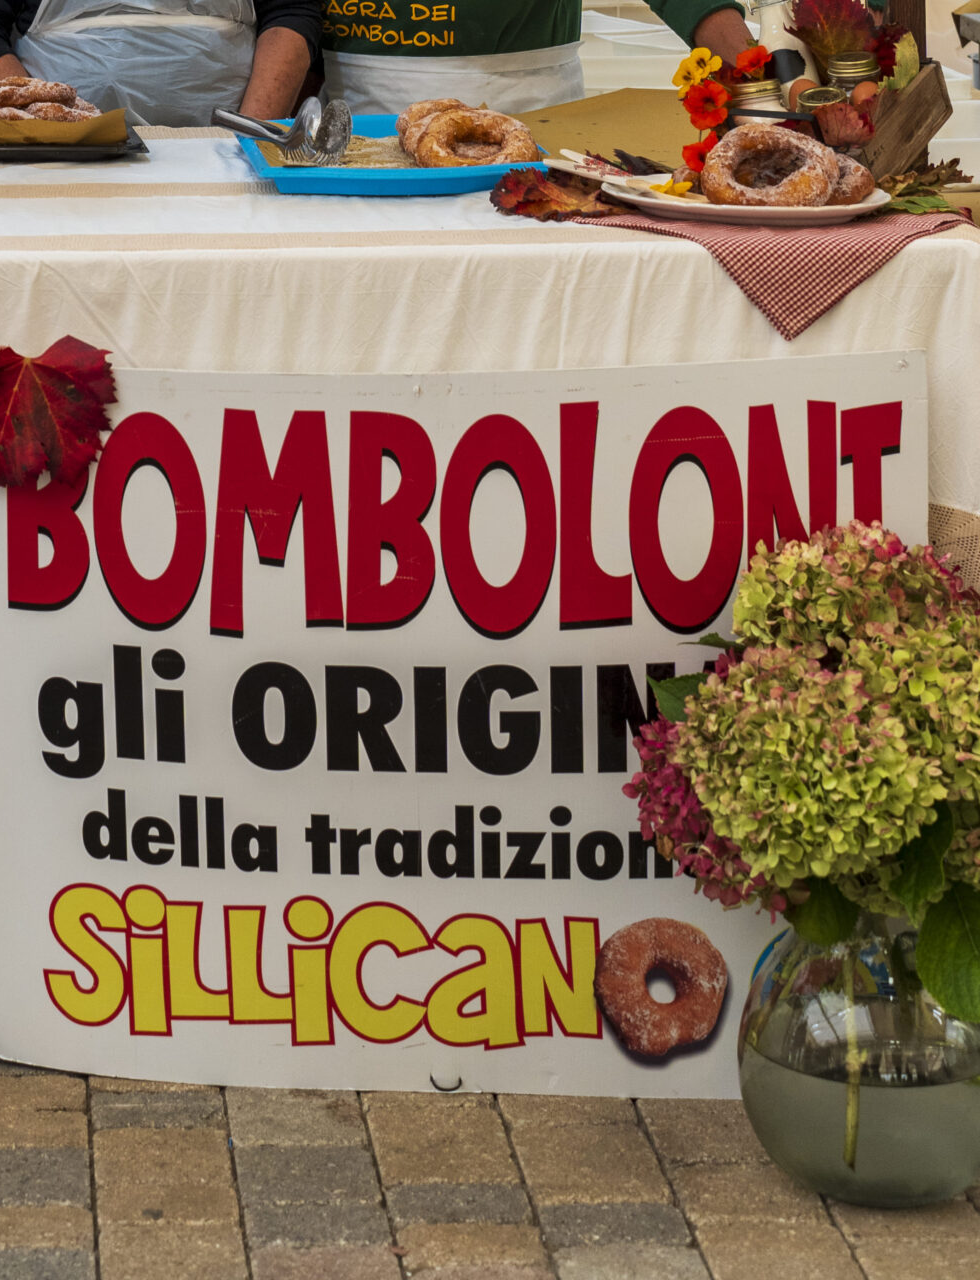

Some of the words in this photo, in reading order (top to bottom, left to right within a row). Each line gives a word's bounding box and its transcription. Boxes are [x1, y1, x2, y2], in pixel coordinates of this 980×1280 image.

[410, 3, 456, 22] DEI
[38, 644, 186, 779] gli
[231, 662, 714, 775] ORIGIN
[81, 787, 278, 873] della
[305, 804, 698, 881] tradizion
